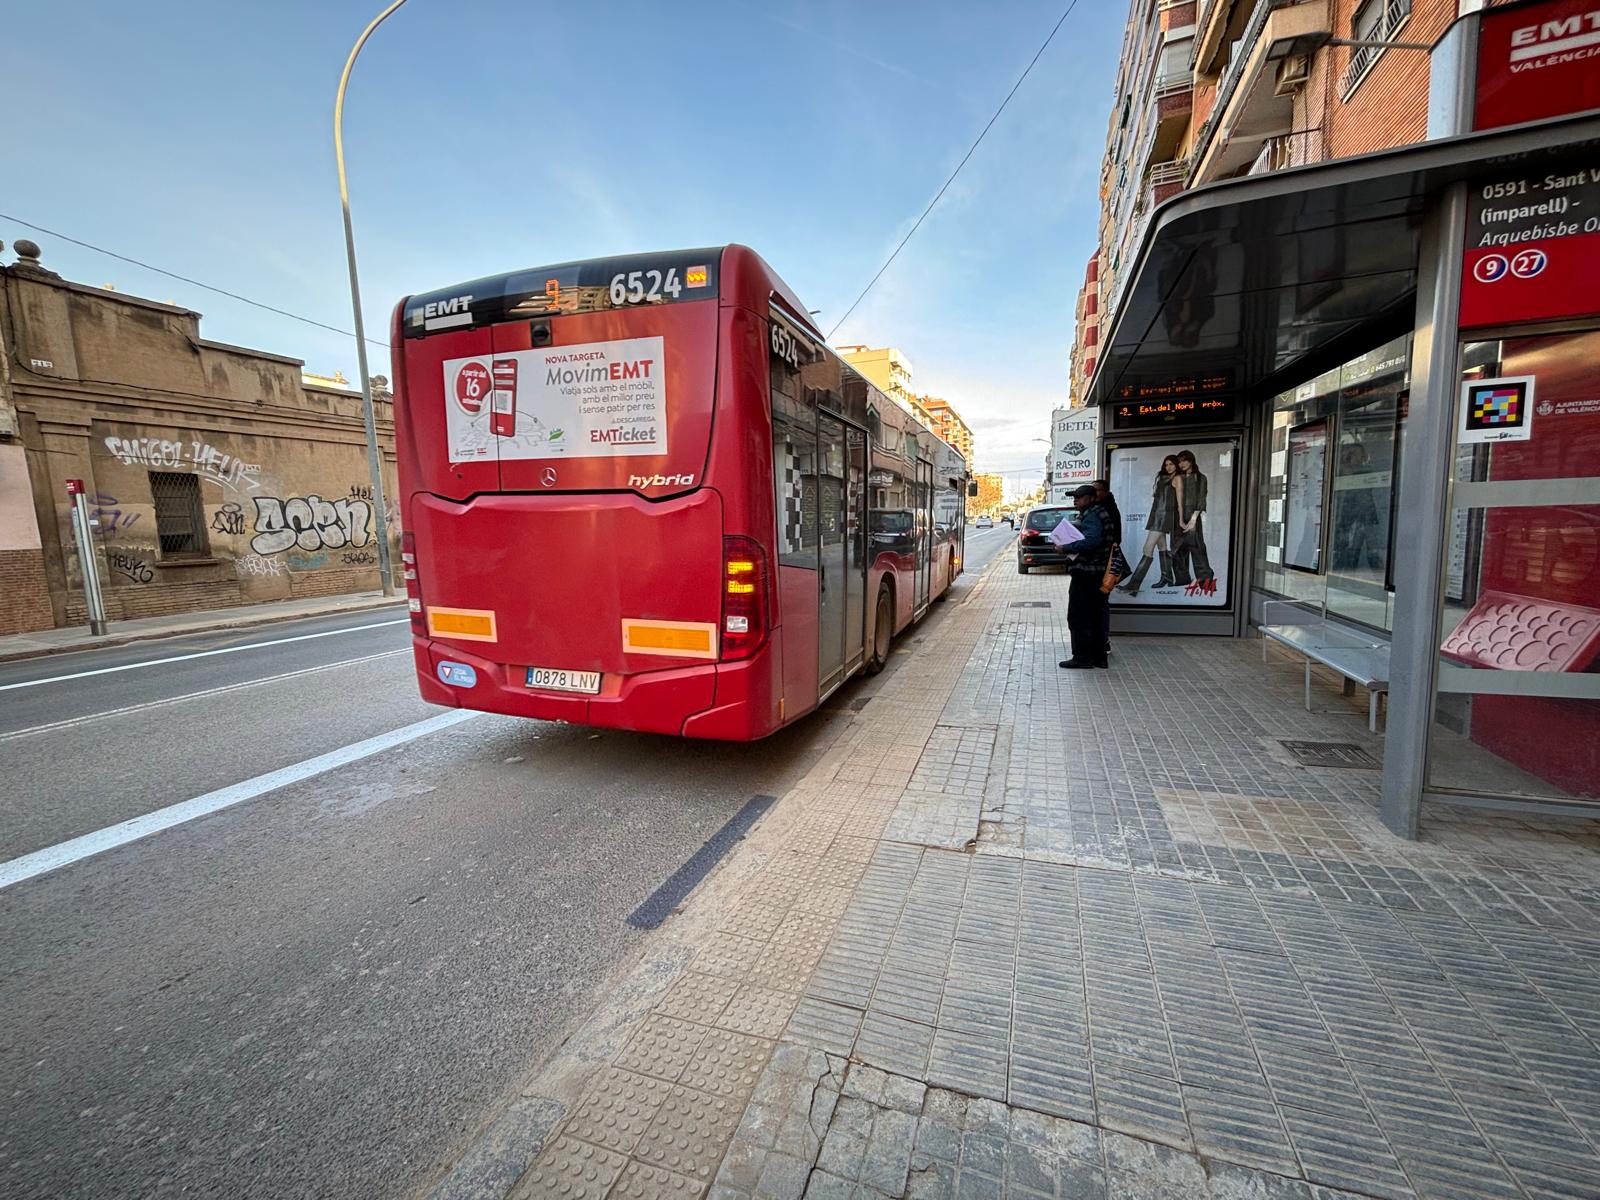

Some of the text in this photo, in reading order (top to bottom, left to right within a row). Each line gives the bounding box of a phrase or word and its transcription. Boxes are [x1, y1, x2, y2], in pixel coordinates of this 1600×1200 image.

[1482, 180, 1527, 200] 0591
[1543, 170, 1586, 190] Sant
[1480, 197, 1568, 225] (imparell)
[1478, 221, 1580, 247] Arquebisbe
[1485, 254, 1542, 276] 9 27
[545, 279, 559, 311] 9
[609, 268, 682, 305] 6524
[425, 295, 473, 318] EMT
[771, 324, 798, 368] 6524
[545, 352, 605, 365] NOVA TARGETA
[546, 360, 653, 386] MovimEMT
[466, 378, 480, 397] 16
[560, 387, 581, 396] Viatja
[599, 384, 617, 392] amb
[619, 383, 627, 391] el
[582, 393, 655, 404] amb el millor preu
[607, 404, 625, 414] patir
[627, 404, 641, 413] per
[643, 403, 656, 411] res
[1175, 402, 1194, 410] Nord
[590, 426, 656, 443] EMTicket
[1056, 459, 1090, 470] RASTRO
[628, 474, 694, 489] hybrid
[1184, 576, 1217, 598] H&M
[535, 670, 597, 688] 0878 LNV
